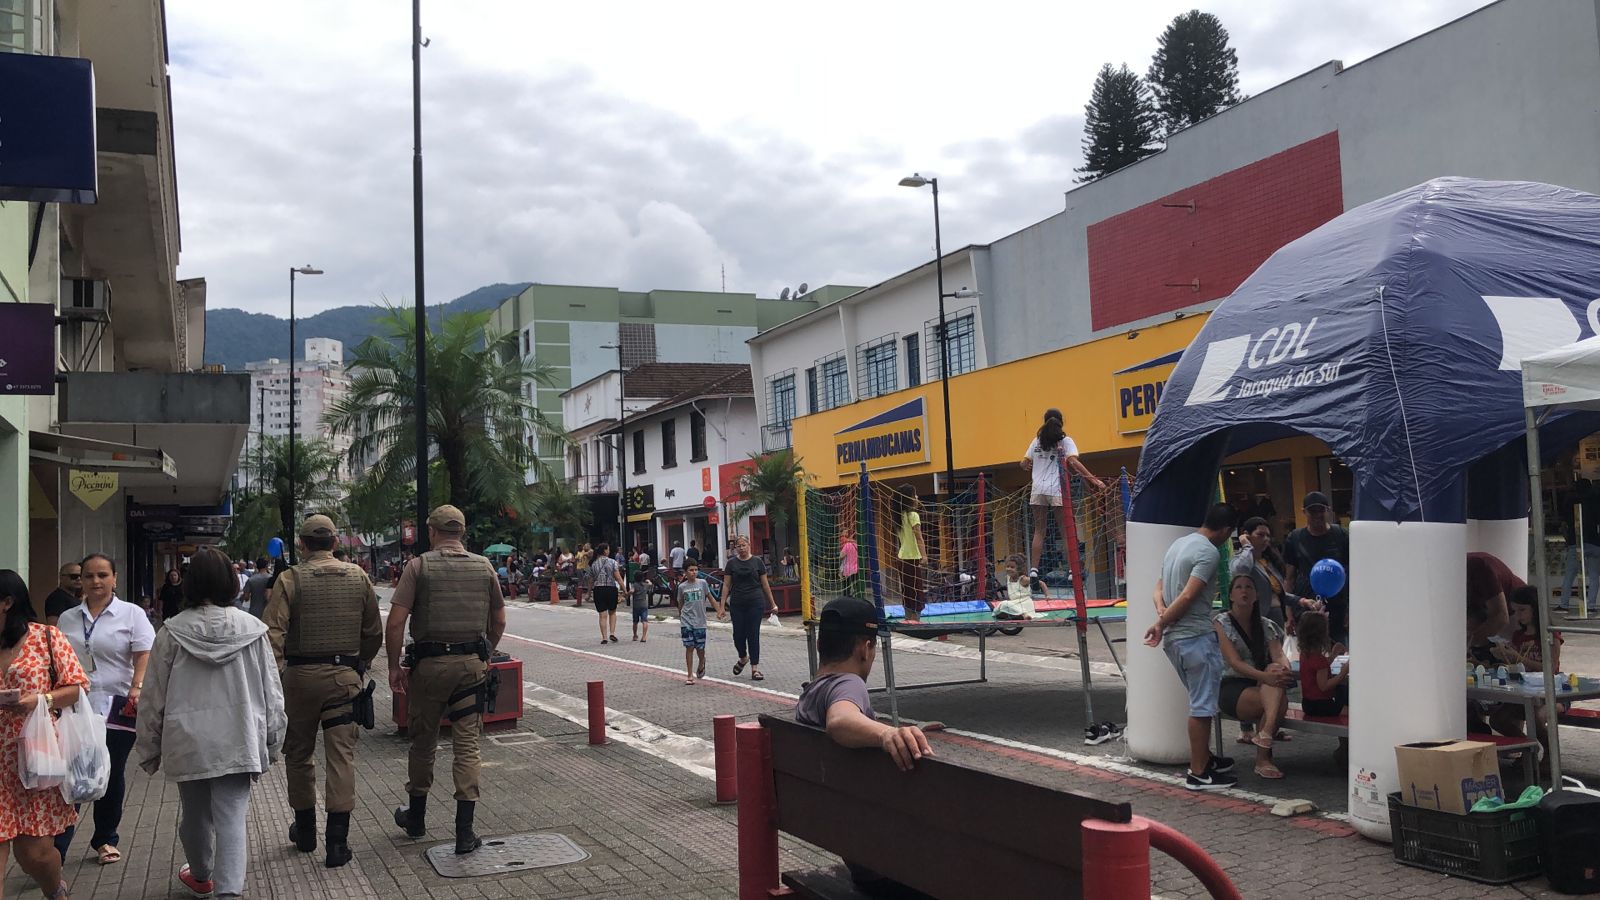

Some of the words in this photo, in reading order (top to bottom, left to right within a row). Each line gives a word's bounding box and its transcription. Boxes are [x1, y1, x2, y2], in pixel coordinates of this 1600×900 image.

[1248, 317, 1318, 368] CDL
[1236, 369, 1293, 399] Jaraguá
[1294, 367, 1315, 387] do
[1315, 358, 1344, 383] Sul
[837, 428, 922, 465] PERNAMBUCANAS
